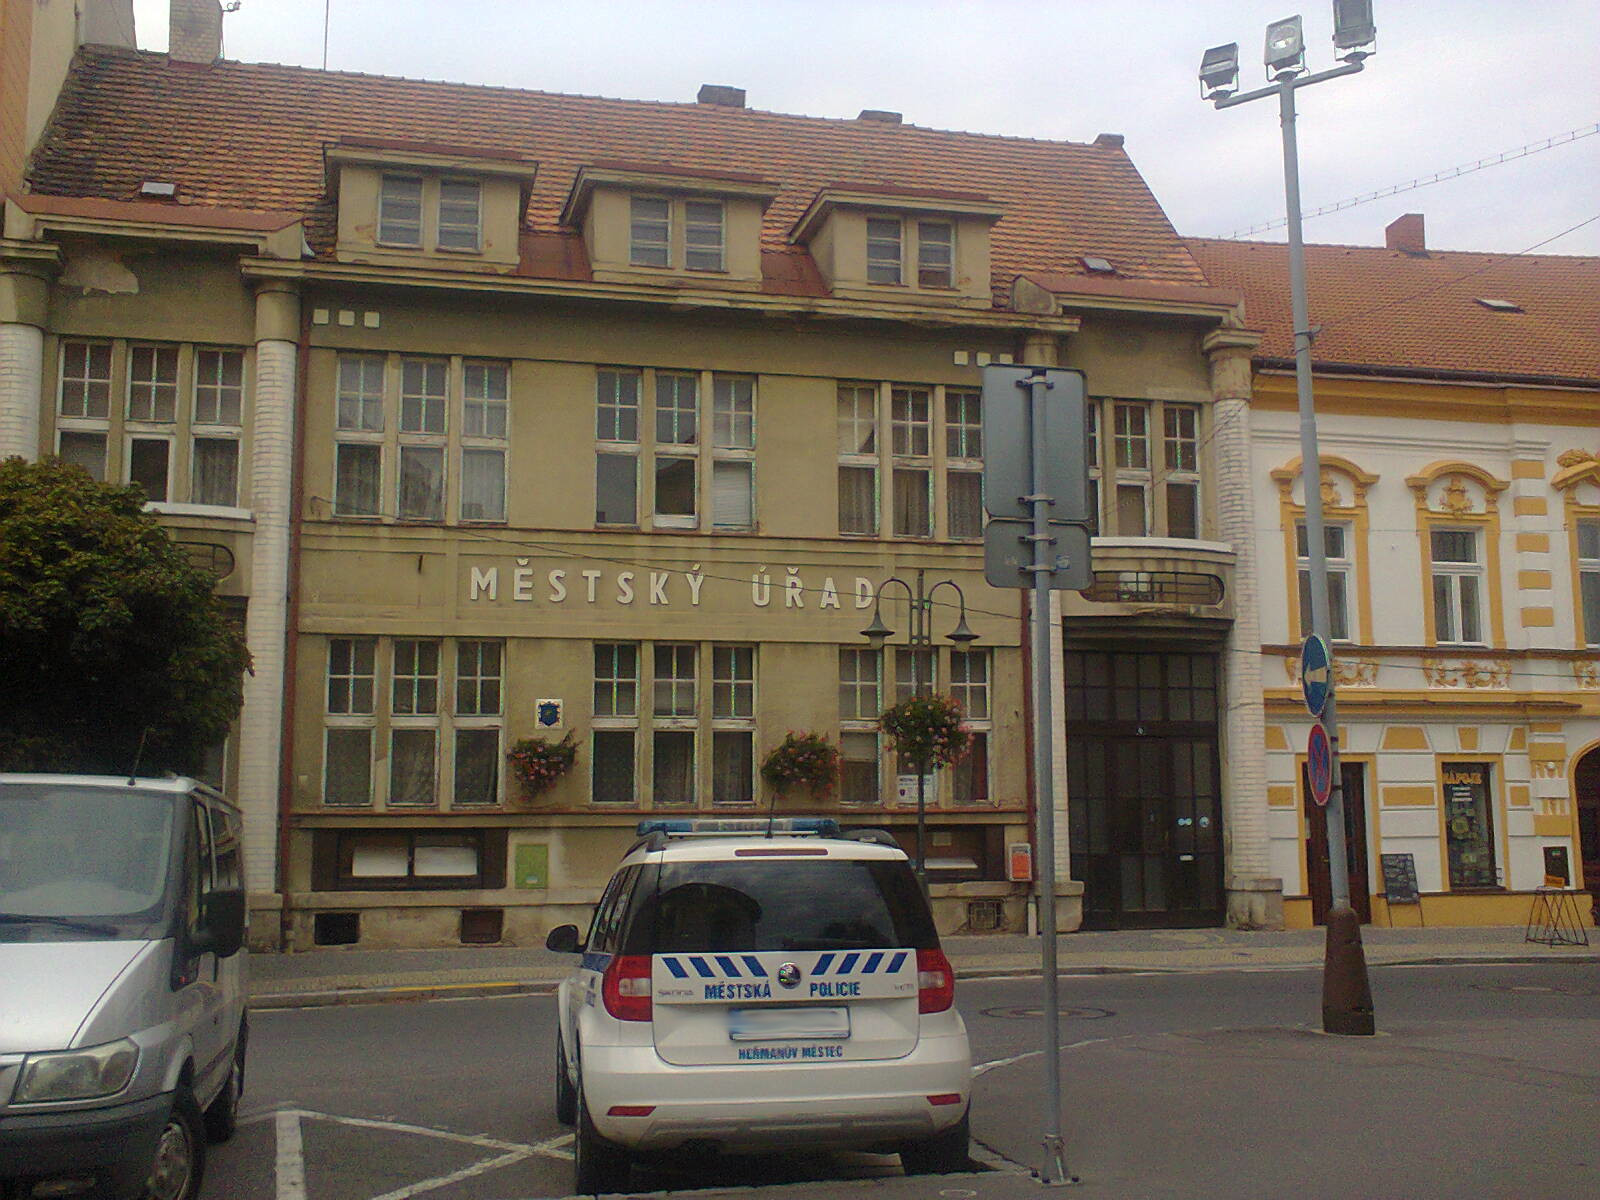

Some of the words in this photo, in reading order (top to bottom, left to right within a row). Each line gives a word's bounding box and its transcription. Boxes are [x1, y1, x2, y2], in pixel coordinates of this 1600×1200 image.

[470, 558, 704, 605] MĚSTSKÝ
[752, 565, 874, 609] ÚŘAD
[810, 982, 861, 998] POLICIE
